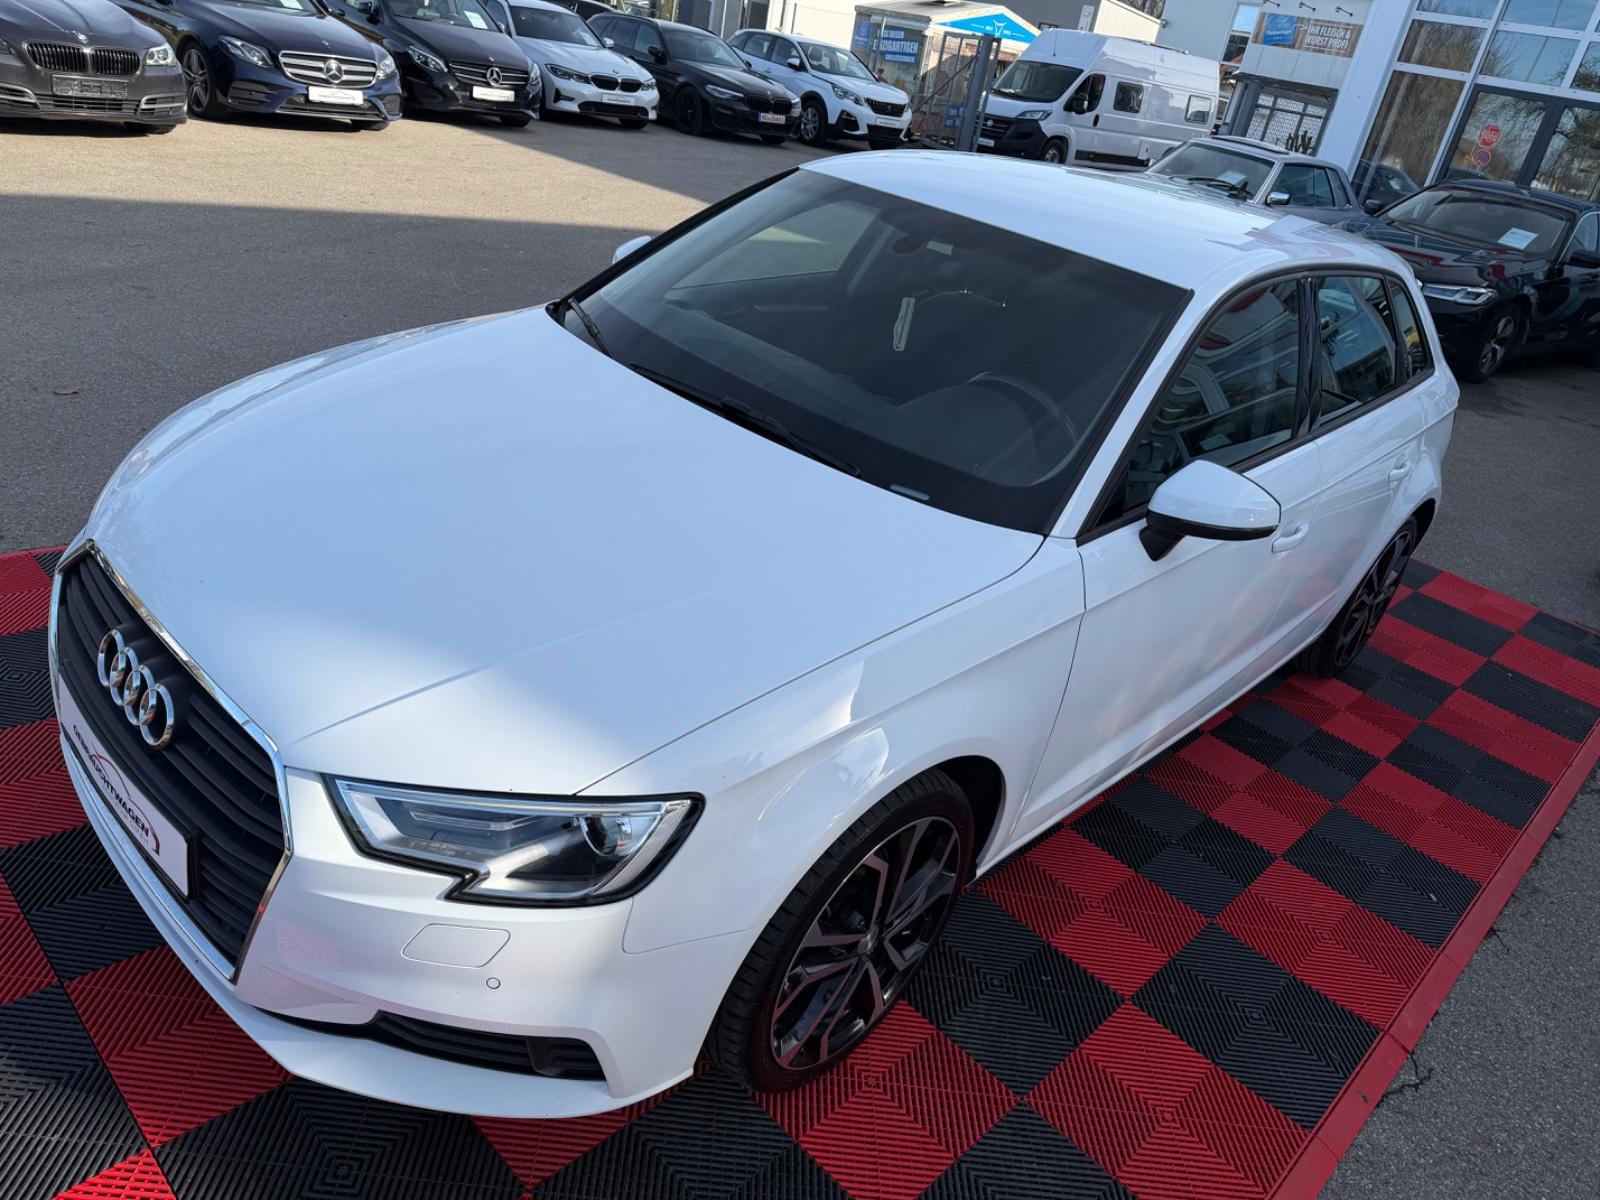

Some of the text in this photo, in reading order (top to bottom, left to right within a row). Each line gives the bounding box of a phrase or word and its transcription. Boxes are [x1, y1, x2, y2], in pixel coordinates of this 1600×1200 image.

[1320, 26, 1345, 38] FLEISCH
[1304, 34, 1328, 46] WURST
[1328, 38, 1349, 50] PROFI
